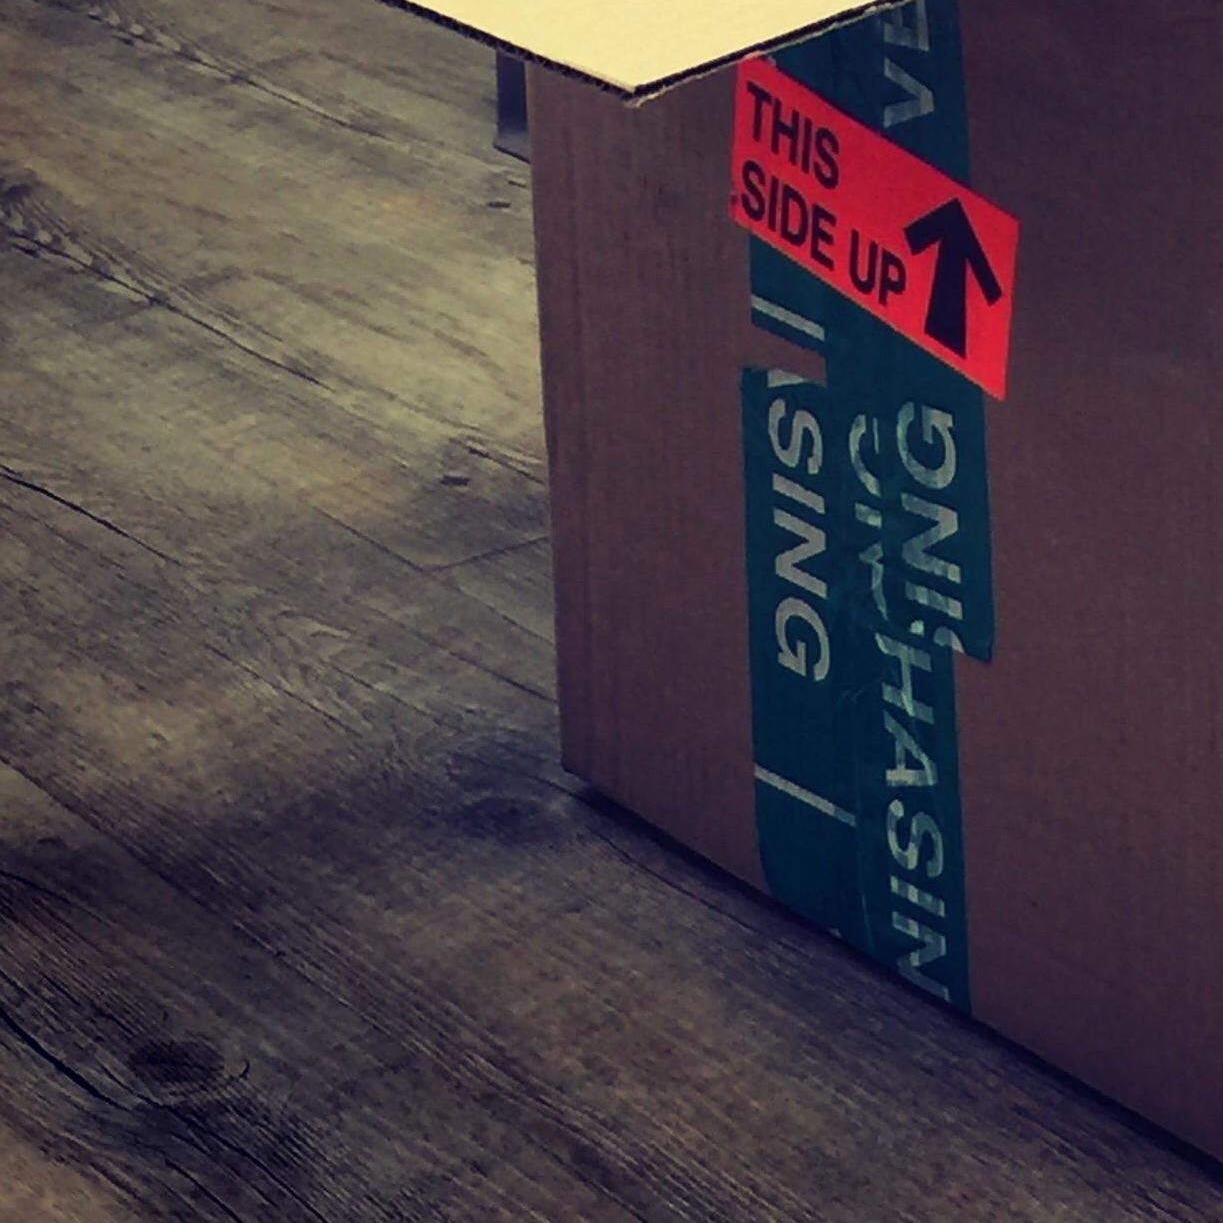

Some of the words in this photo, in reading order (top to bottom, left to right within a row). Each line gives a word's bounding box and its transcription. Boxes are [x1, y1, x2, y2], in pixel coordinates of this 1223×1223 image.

[746, 82, 840, 189] THIS
[741, 160, 837, 271] SIDE
[849, 230, 907, 306] UP
[874, 619, 950, 1003] HASIN
